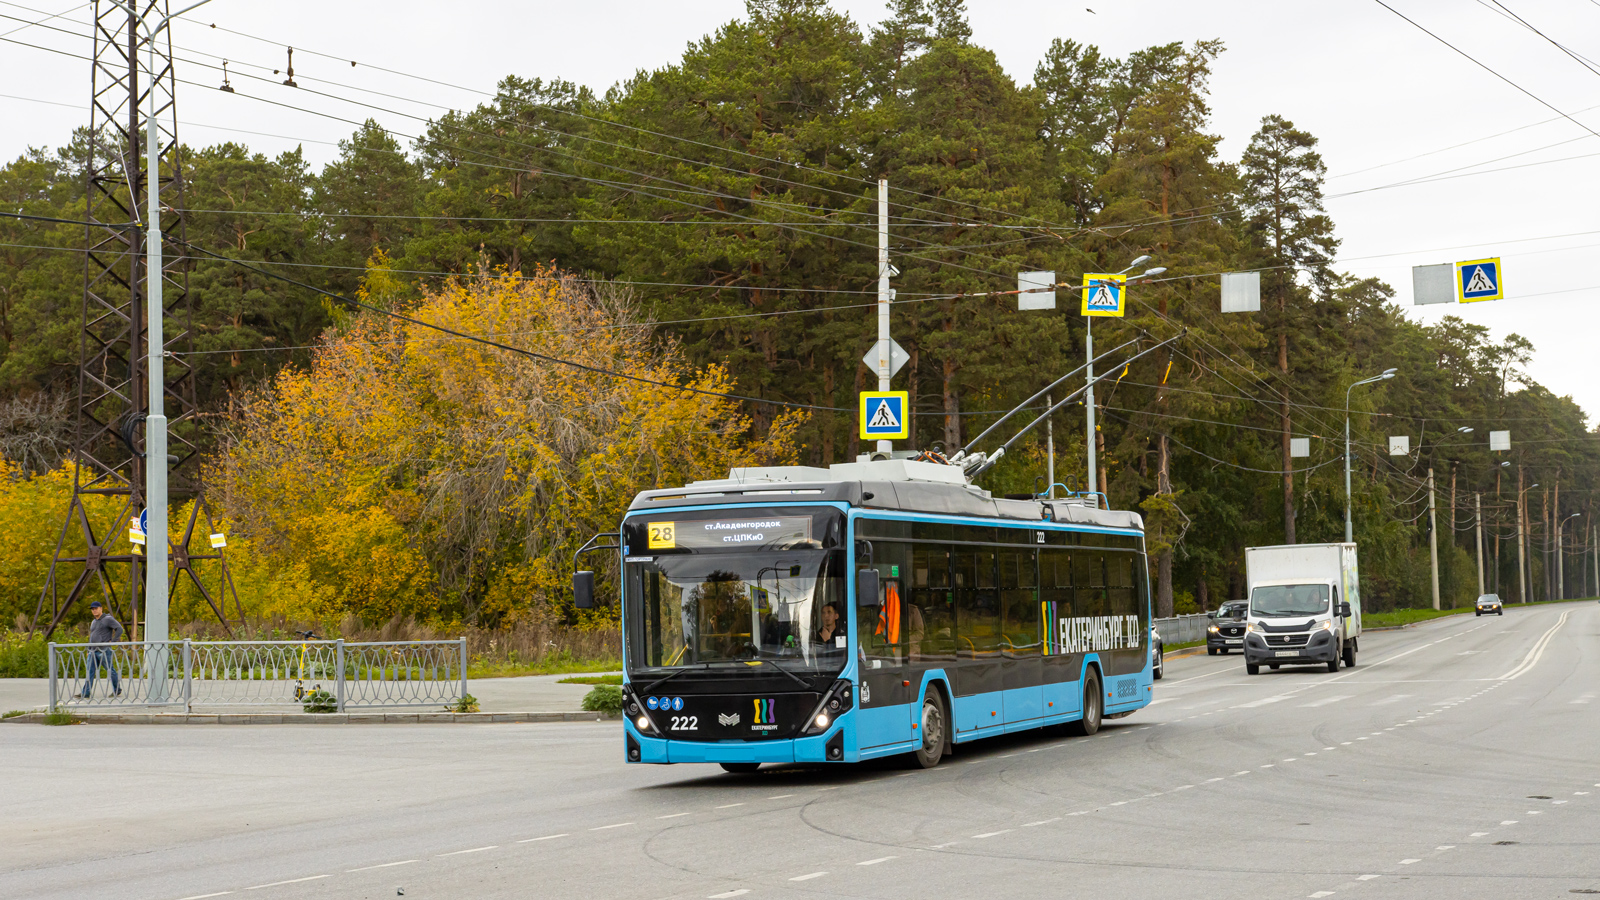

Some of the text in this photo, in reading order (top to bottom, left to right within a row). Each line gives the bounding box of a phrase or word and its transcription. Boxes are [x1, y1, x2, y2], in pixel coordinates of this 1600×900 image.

[704, 520, 781, 530] ст.Академгородок
[651, 527, 672, 542] 28
[723, 533, 764, 542] ст.ЦПКиО
[1036, 531, 1045, 543] 222
[1059, 615, 1123, 654] ЕКАТЕРИНБУРГ
[670, 715, 698, 730] 222
